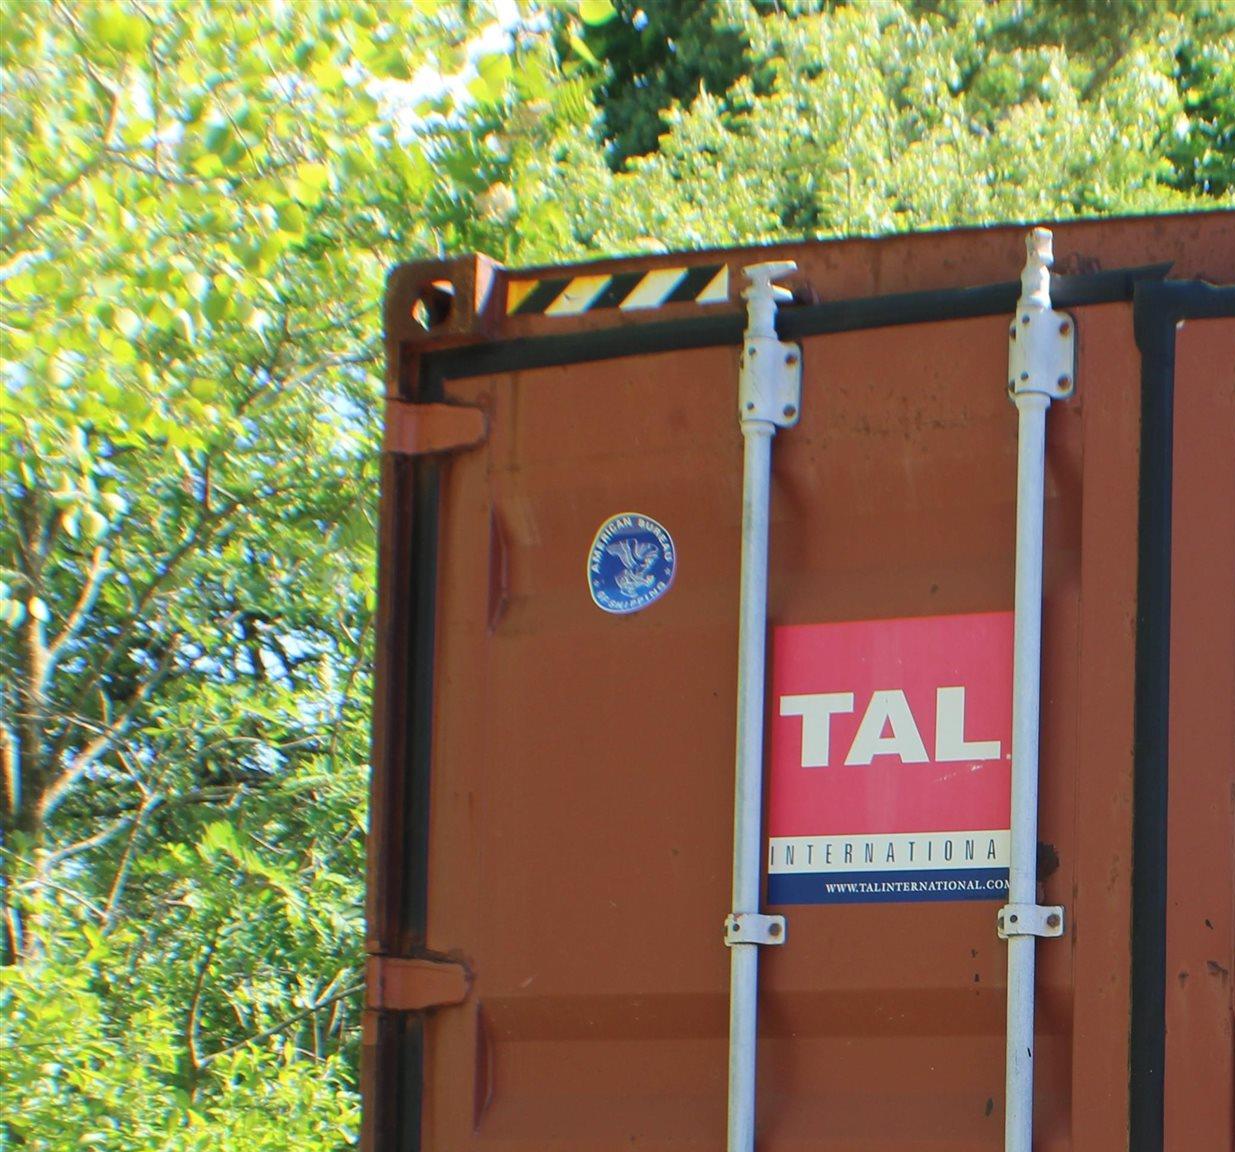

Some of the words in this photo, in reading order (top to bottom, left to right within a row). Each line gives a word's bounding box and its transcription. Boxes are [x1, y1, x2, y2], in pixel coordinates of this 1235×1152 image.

[591, 517, 632, 574] AMERICAN
[637, 518, 673, 562] BUREAU
[779, 686, 1001, 768] TAL
[770, 839, 997, 866] INTERNATIONA
